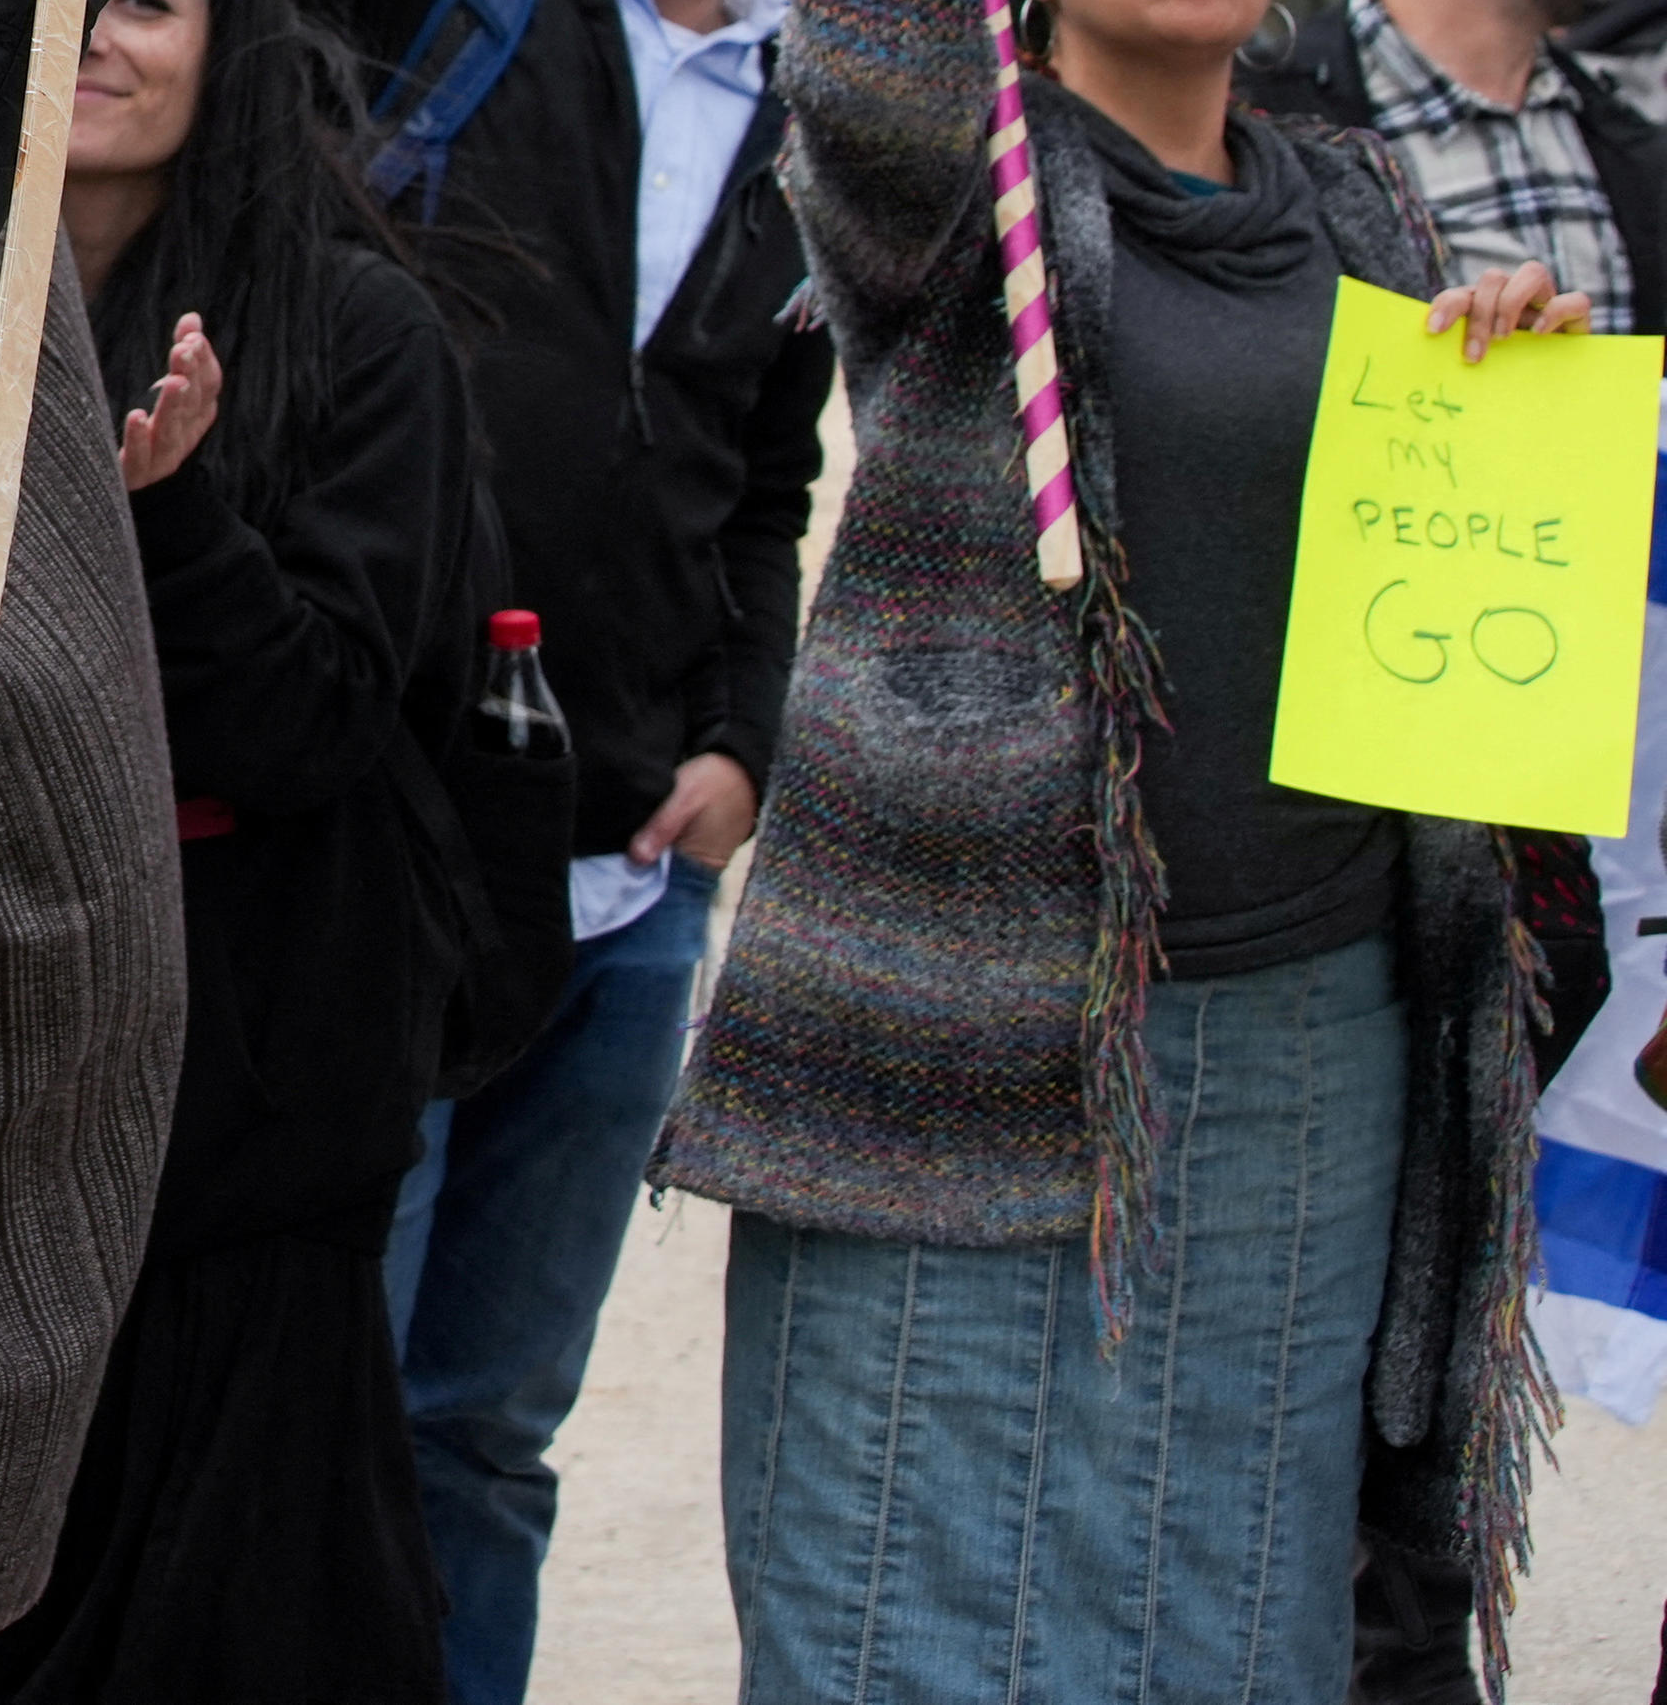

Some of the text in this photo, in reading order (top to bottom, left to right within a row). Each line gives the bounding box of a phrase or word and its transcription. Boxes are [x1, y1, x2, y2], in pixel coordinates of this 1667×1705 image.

[1350, 355, 1464, 423] Let
[1352, 498, 1569, 567] PEOPLE
[1364, 578, 1559, 686] GO
